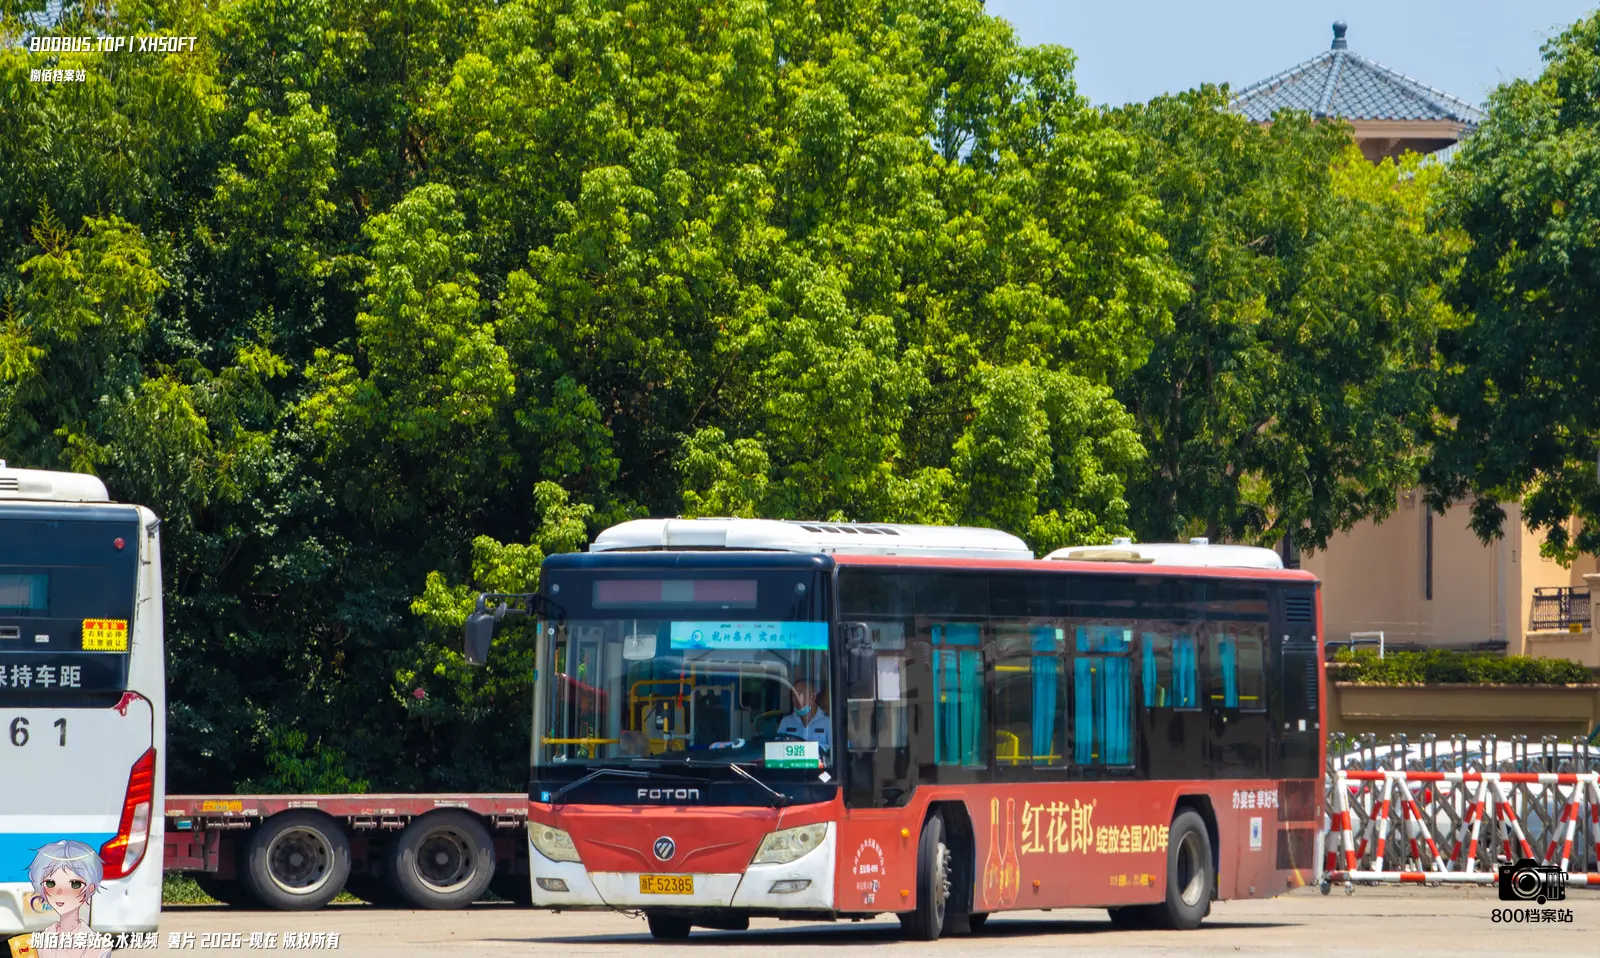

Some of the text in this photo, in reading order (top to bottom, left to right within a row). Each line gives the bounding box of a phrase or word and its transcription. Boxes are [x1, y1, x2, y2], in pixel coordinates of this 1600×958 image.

[786, 744, 805, 757] 9路
[637, 788, 700, 800] FOTON
[1021, 798, 1094, 855] 红花郎
[1096, 824, 1170, 854] 绽放全国20年
